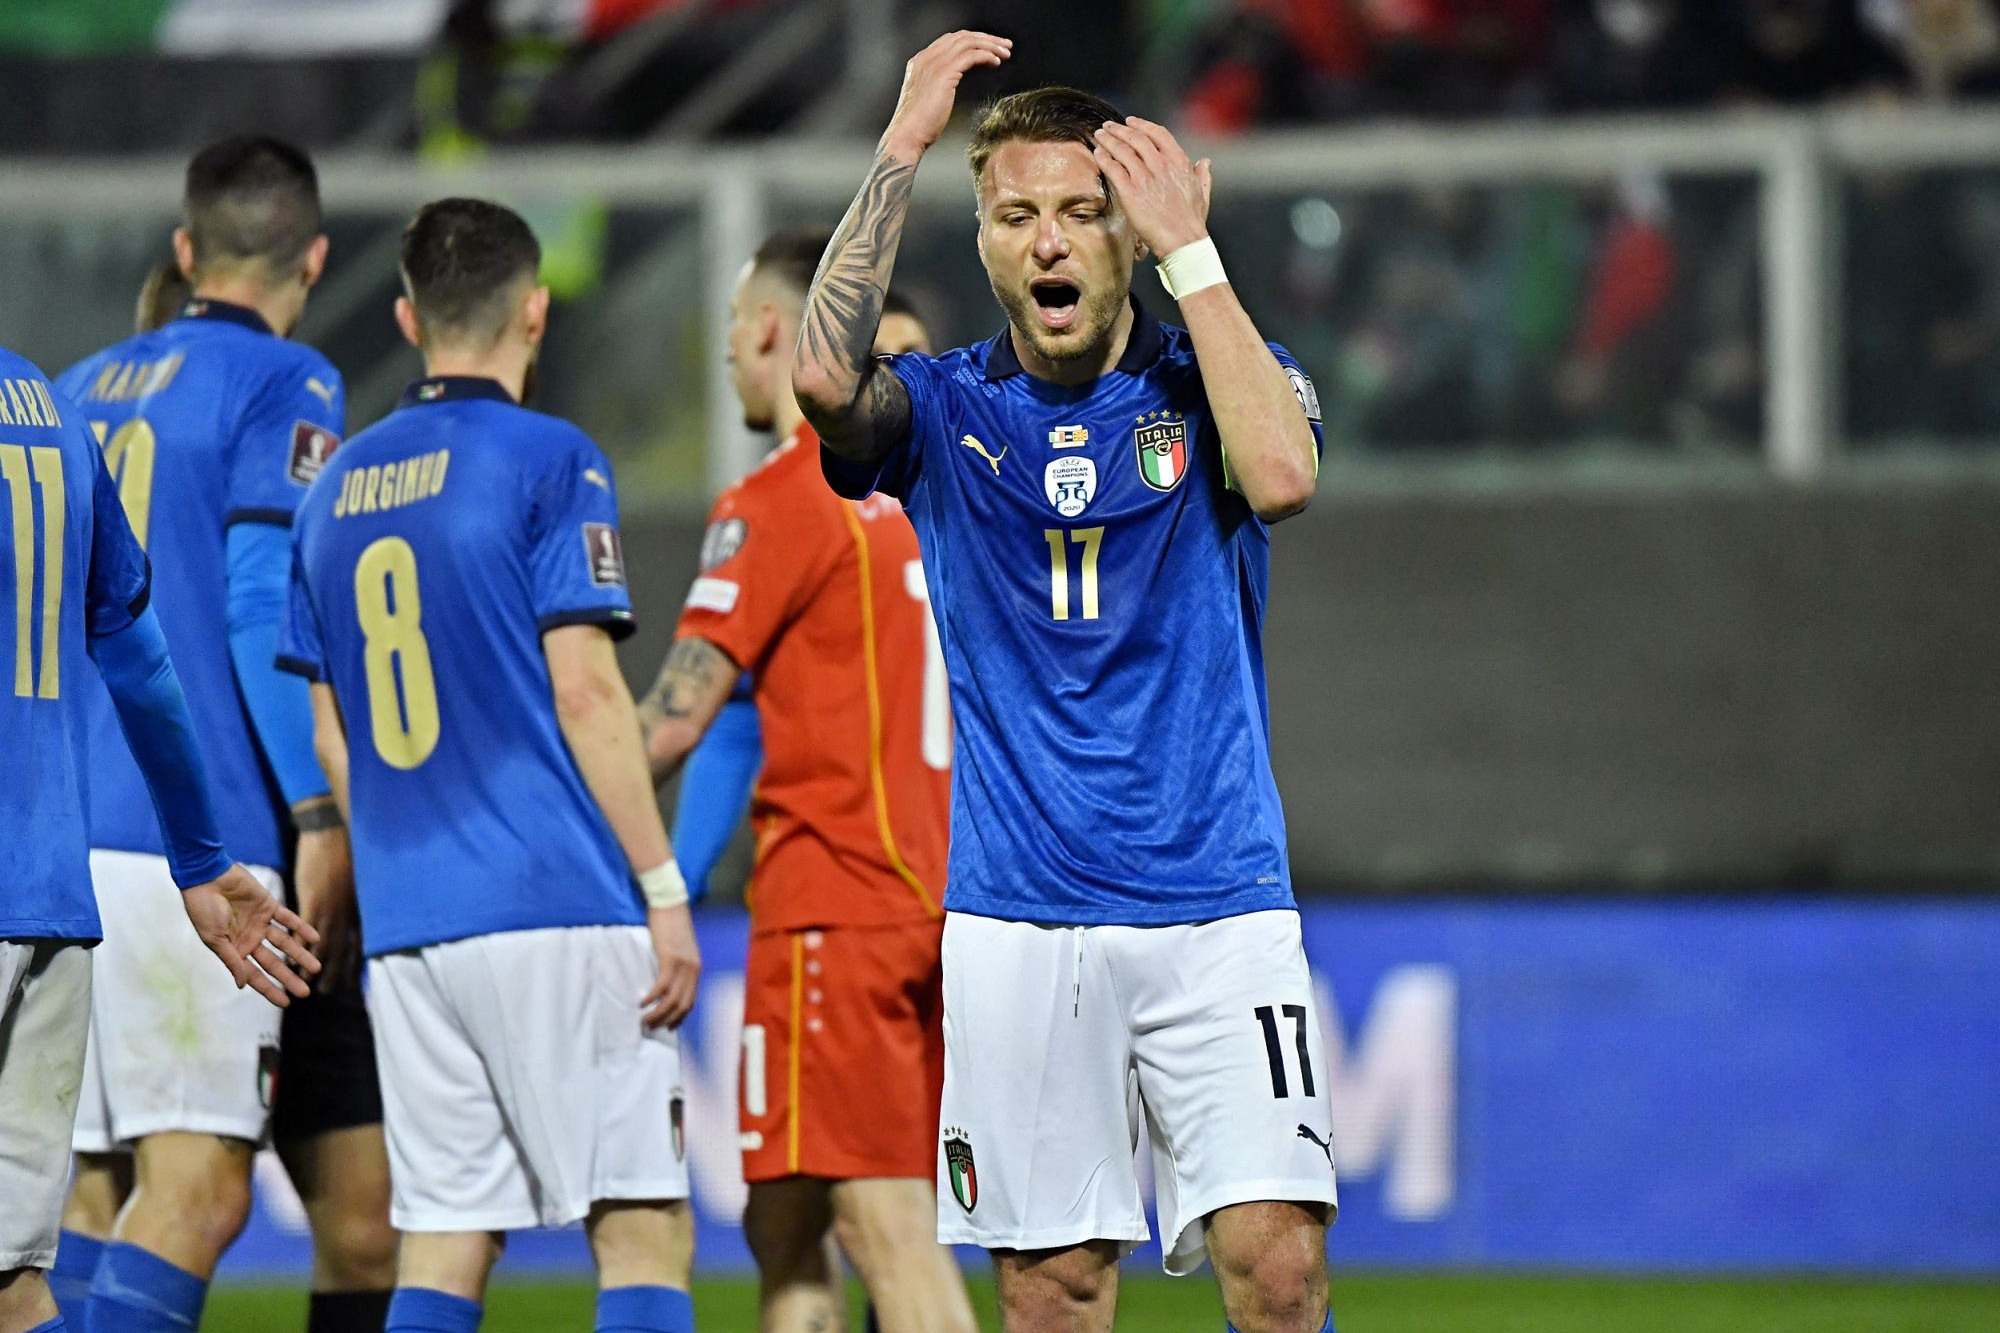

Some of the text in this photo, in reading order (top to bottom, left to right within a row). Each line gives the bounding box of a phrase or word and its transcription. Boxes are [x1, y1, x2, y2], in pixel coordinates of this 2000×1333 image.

[0, 378, 62, 428] RARDI
[1140, 427, 1182, 443] ITALIA
[334, 448, 449, 518] JORGINHO
[0, 443, 65, 700] 11
[1044, 526, 1105, 620] 17
[355, 535, 441, 770] 8
[1254, 1004, 1316, 1099] 17
[948, 1144, 972, 1159] ITALIA
